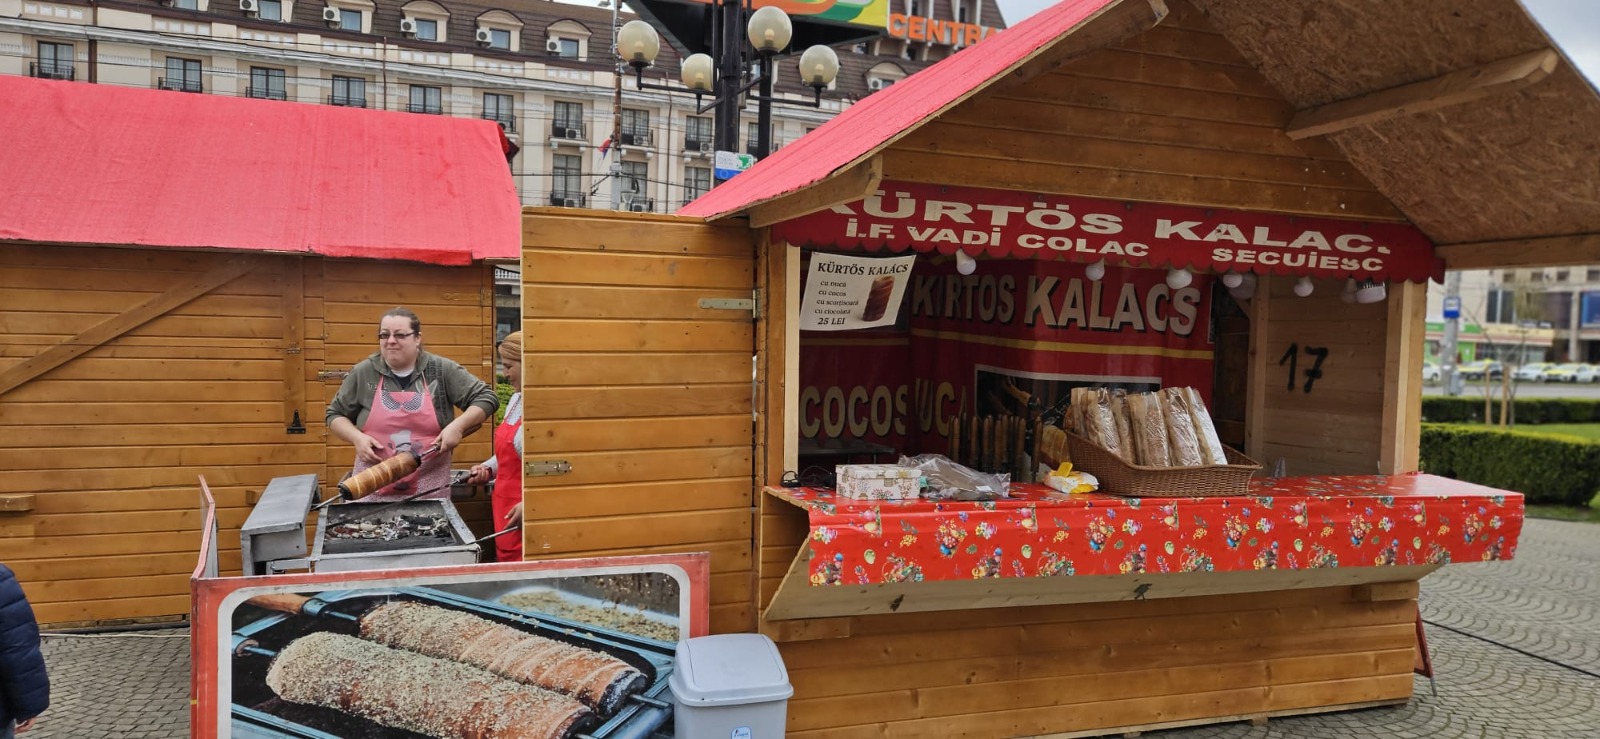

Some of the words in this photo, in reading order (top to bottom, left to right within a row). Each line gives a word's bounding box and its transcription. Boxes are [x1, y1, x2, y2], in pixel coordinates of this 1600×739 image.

[1016, 233, 1150, 257] COLAC
[818, 262, 865, 276] KÜRTÖS
[867, 263, 909, 276] KALÁCS
[1024, 275, 1201, 337] KALACS
[818, 317, 830, 325] 25
[831, 317, 845, 325] LEI
[1279, 342, 1329, 394] 17
